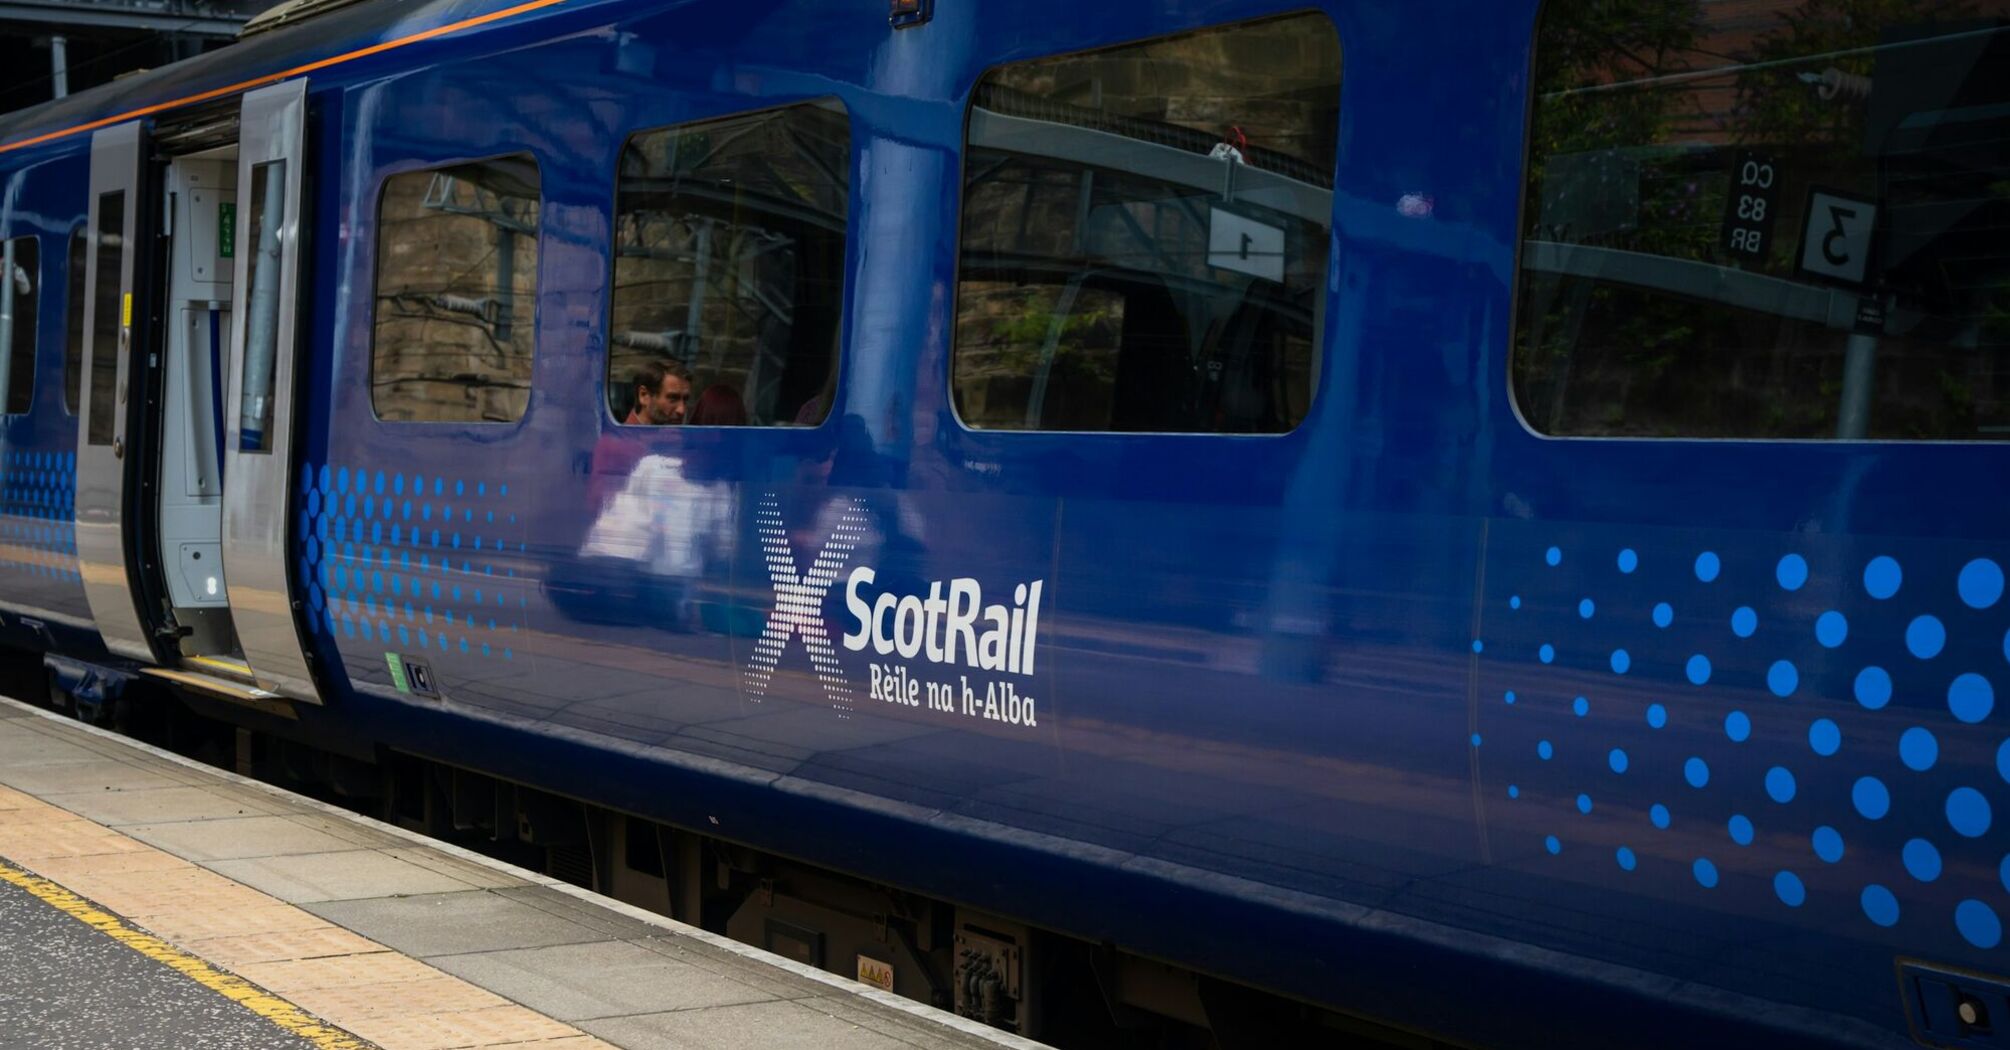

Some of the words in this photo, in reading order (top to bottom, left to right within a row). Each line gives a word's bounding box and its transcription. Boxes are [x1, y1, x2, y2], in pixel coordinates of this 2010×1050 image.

[843, 566, 1044, 676] ScotRail
[869, 662, 919, 707] Rèile
[926, 681, 954, 713] na
[960, 675, 1037, 727] h-Alba
